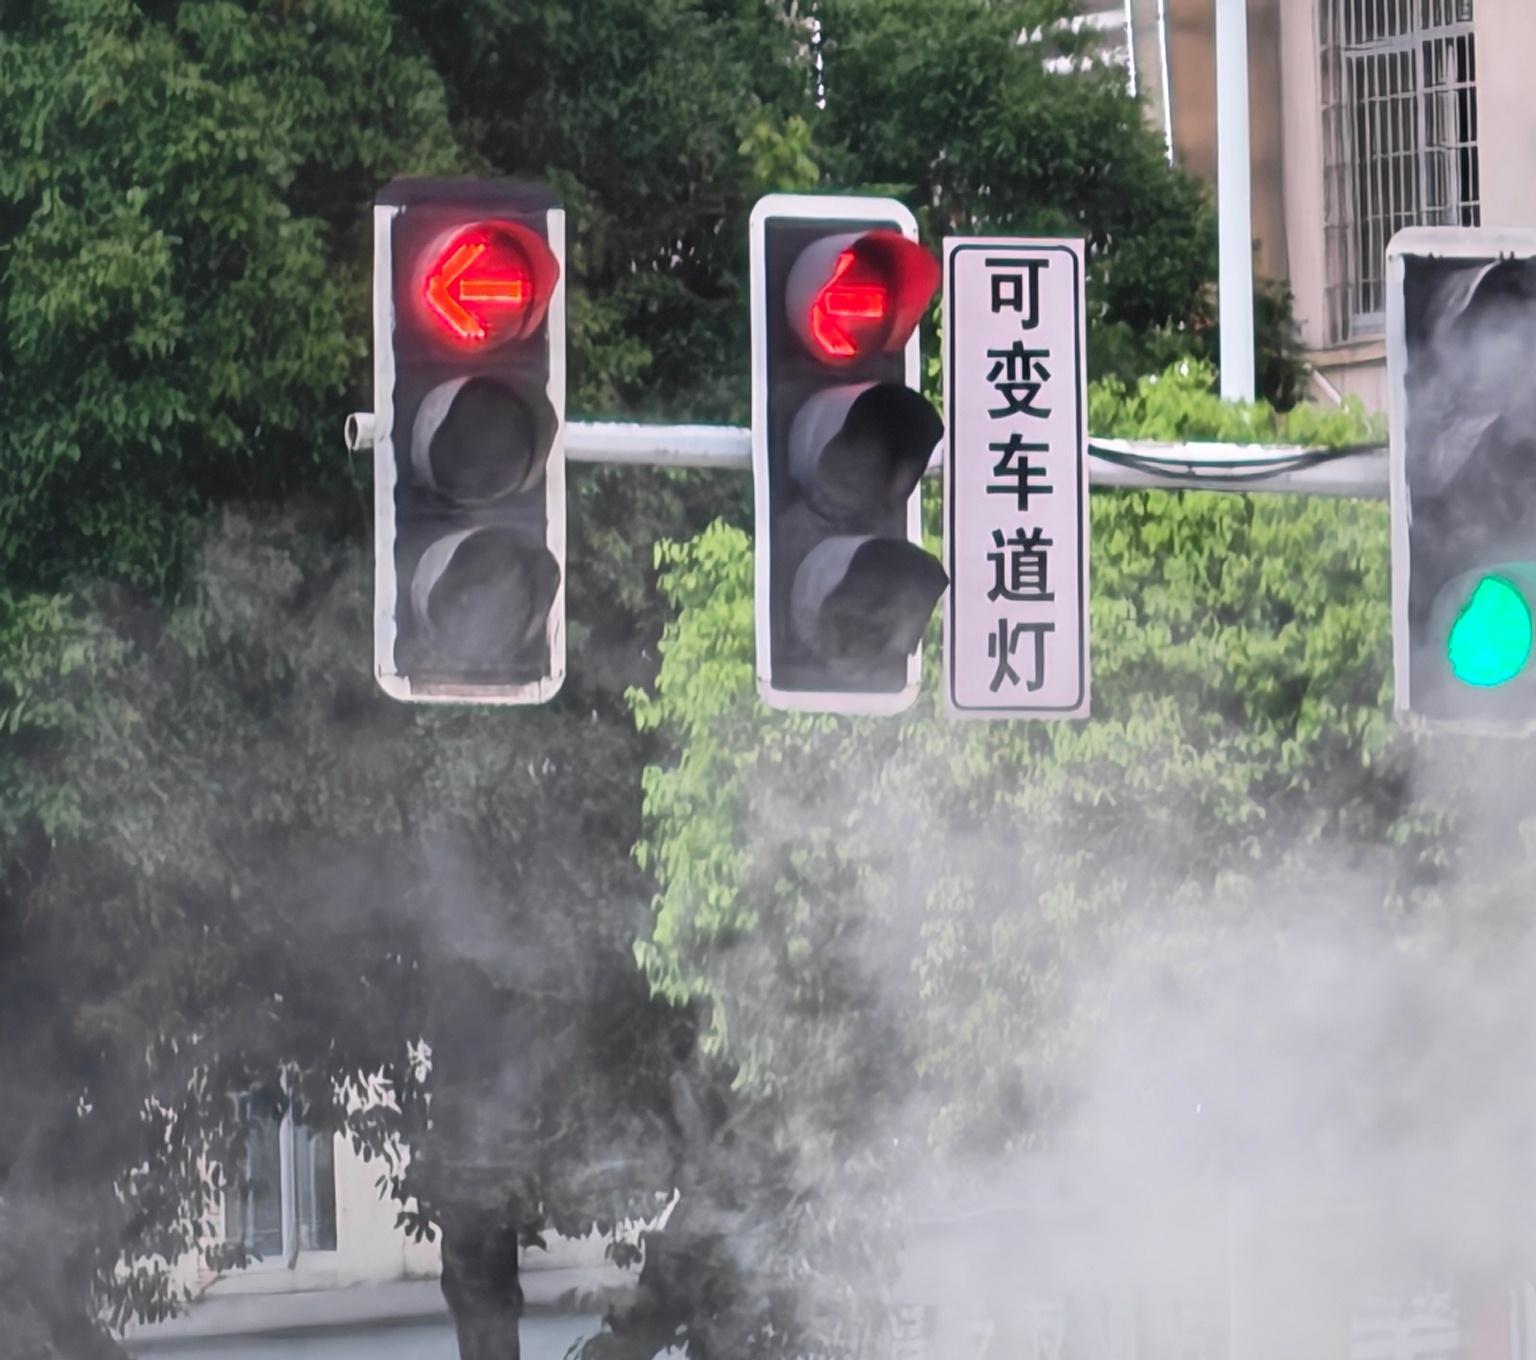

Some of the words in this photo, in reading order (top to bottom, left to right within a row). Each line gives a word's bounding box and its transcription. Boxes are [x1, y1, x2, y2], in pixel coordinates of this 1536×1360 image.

[985, 256, 1055, 694] 可变车道灯
